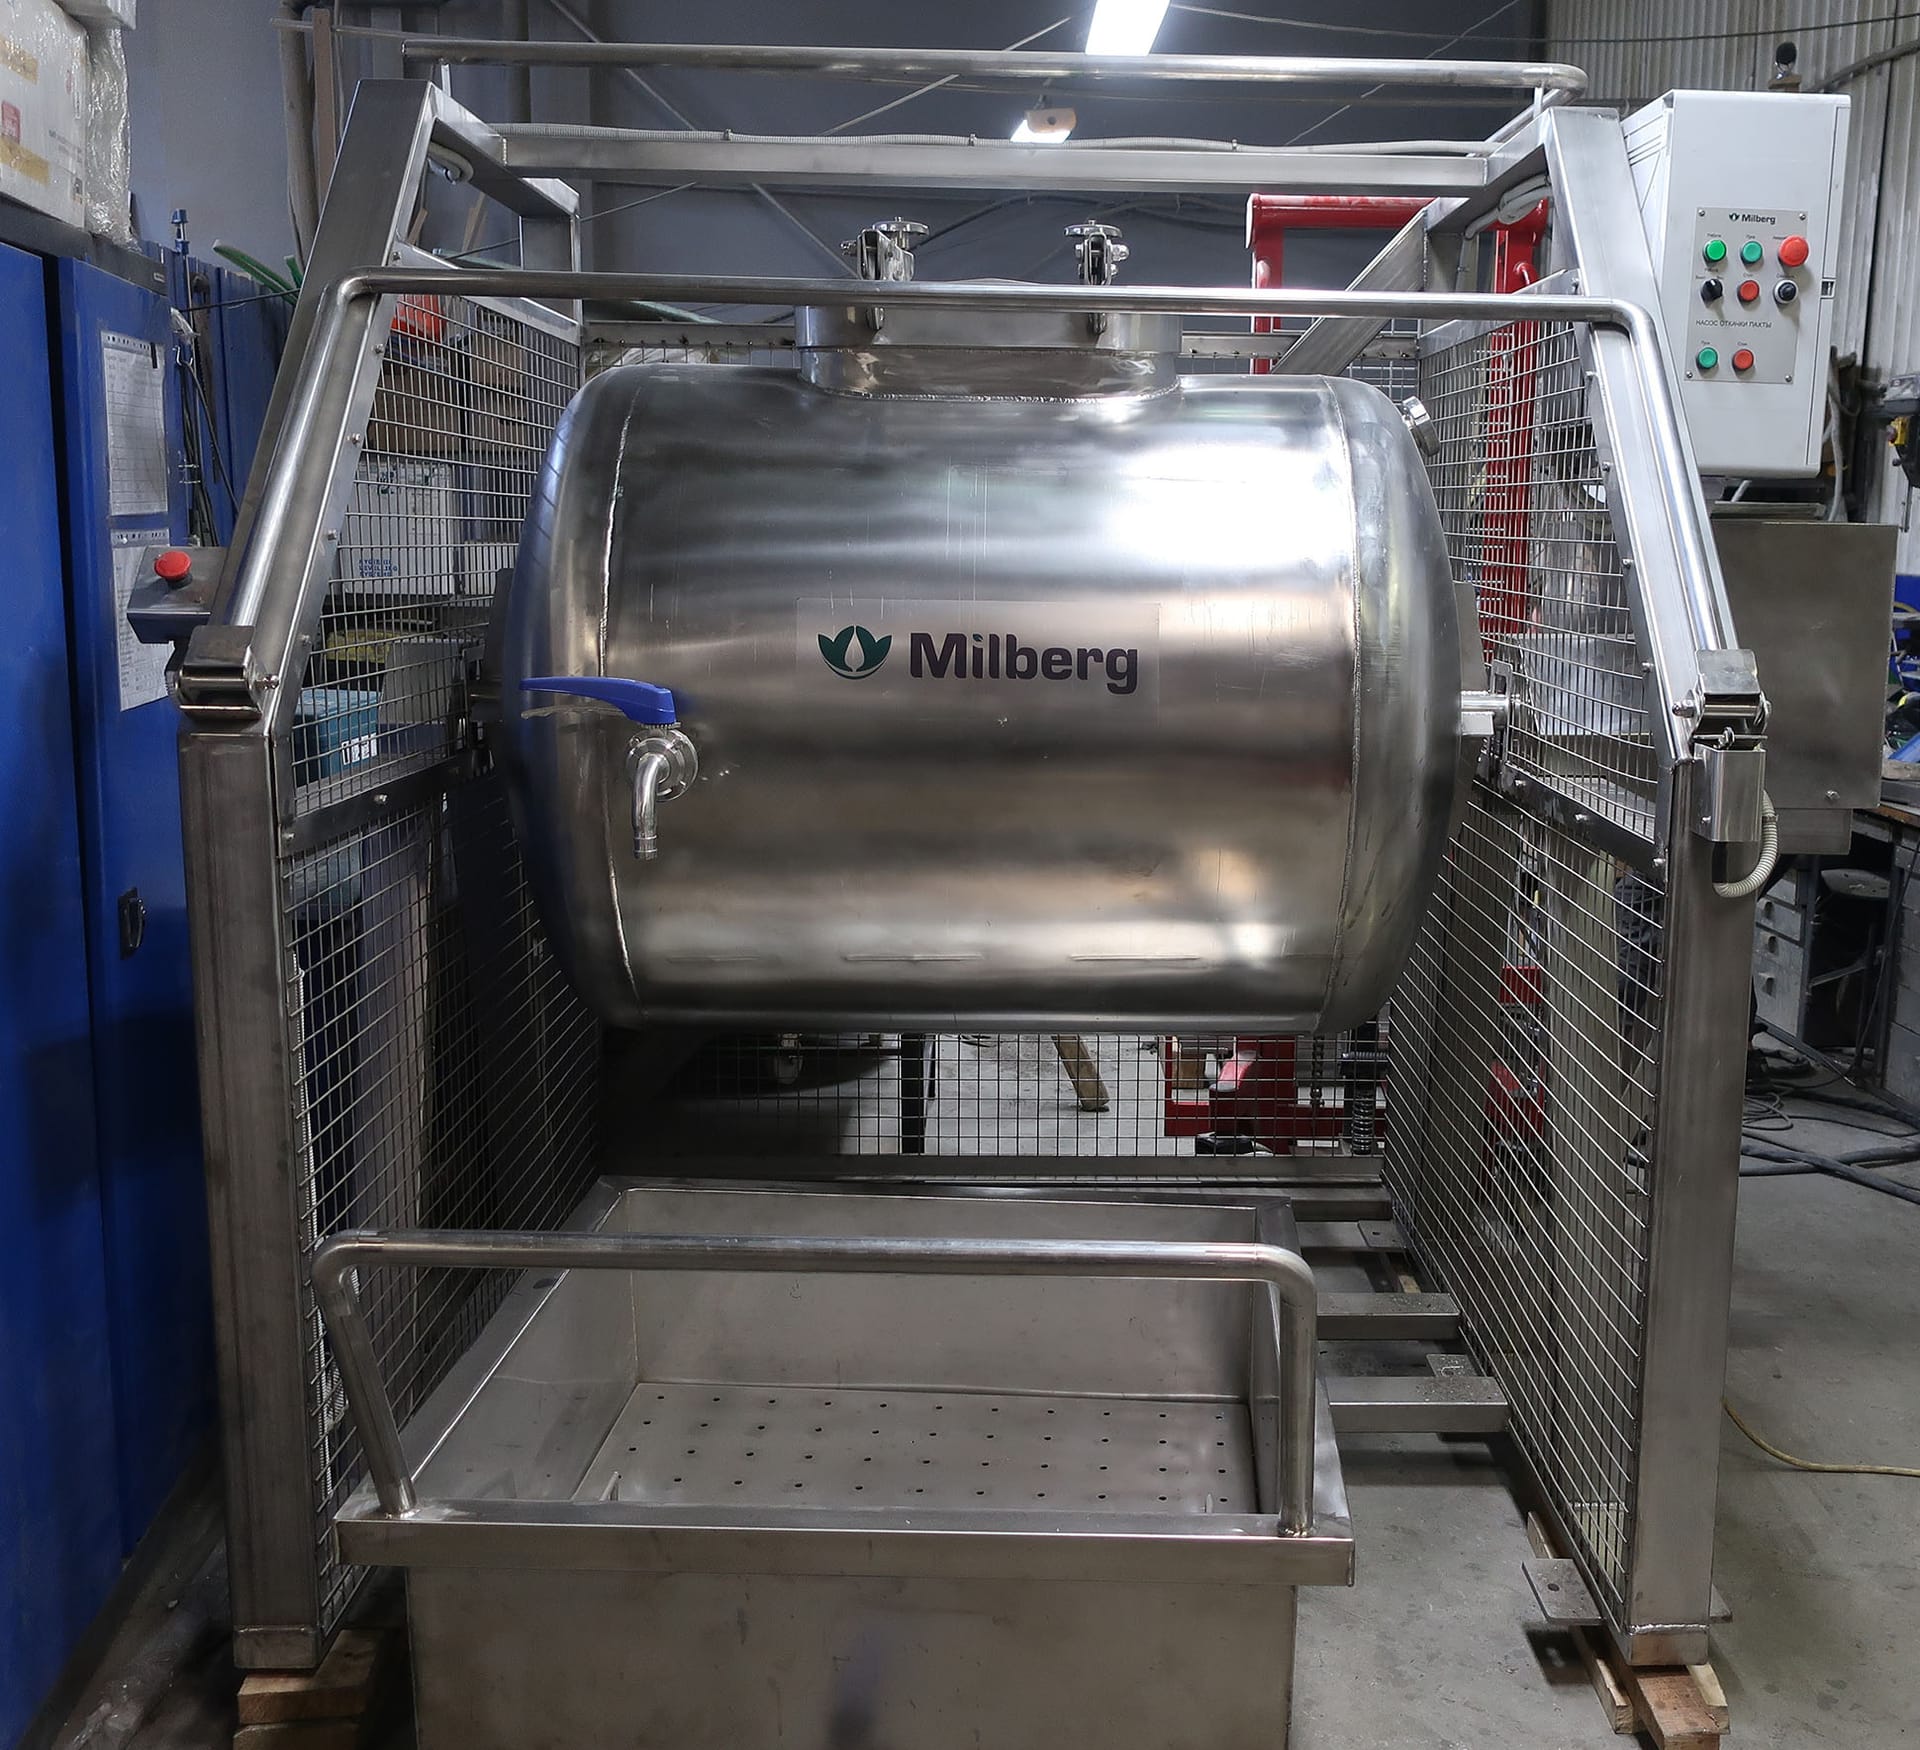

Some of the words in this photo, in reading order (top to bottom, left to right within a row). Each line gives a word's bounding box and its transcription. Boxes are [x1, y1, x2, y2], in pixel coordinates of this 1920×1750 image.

[1741, 214, 1776, 225] Milberg
[1696, 319, 1718, 327] НАСОС
[1719, 320, 1748, 328] ОТКАЧКИ
[910, 633, 1139, 694] Milberg
